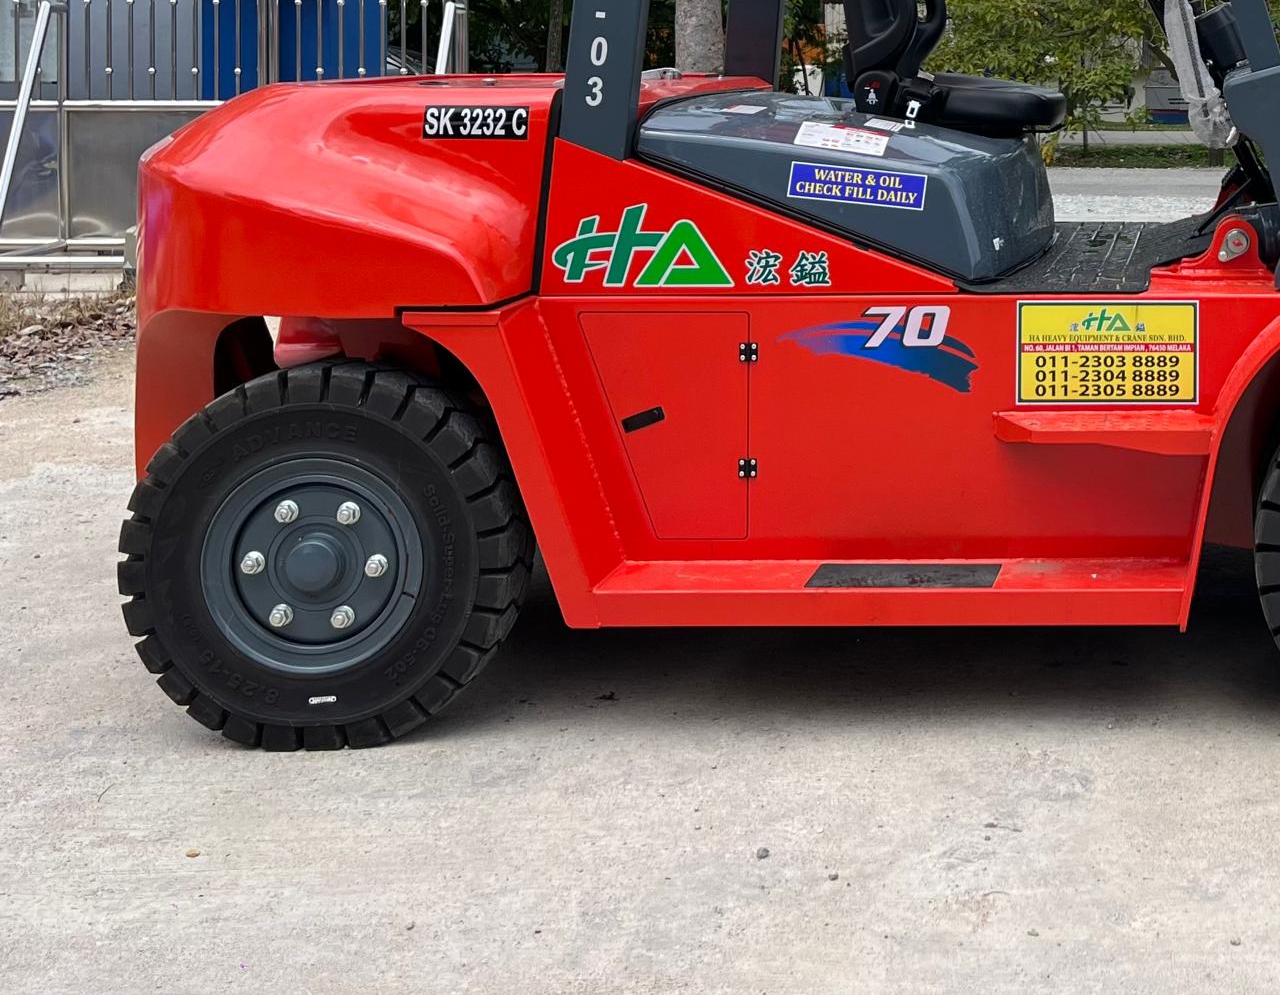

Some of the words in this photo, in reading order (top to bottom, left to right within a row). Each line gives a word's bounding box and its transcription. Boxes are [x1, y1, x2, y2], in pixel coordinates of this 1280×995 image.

[425, 107, 456, 135] SK
[460, 108, 507, 136] 3232
[512, 108, 528, 136] C
[814, 168, 862, 185] WATER
[865, 174, 876, 186] &
[879, 176, 903, 188] OIL
[796, 181, 842, 197] CHECK
[844, 187, 874, 200] FILL
[876, 189, 918, 204] DAILY
[861, 305, 951, 350] 70
[1029, 334, 1041, 342] HA
[1042, 334, 1068, 342] HEAVY
[1069, 334, 1114, 344] EQUIPMENT
[1115, 334, 1120, 342] &
[1122, 334, 1147, 342] CRANE
[1148, 334, 1166, 342] SDN.
[1046, 344, 1064, 352] JALAN
[1077, 344, 1099, 352] TAMAN
[1167, 344, 1191, 352] MELAKA
[1035, 355, 1127, 368] 011-2303
[1132, 355, 1180, 368] 8889
[1035, 370, 1127, 382] 011-2304
[1132, 370, 1180, 382] 8889
[1035, 384, 1127, 397] 011-2305
[1132, 384, 1180, 397] 8889
